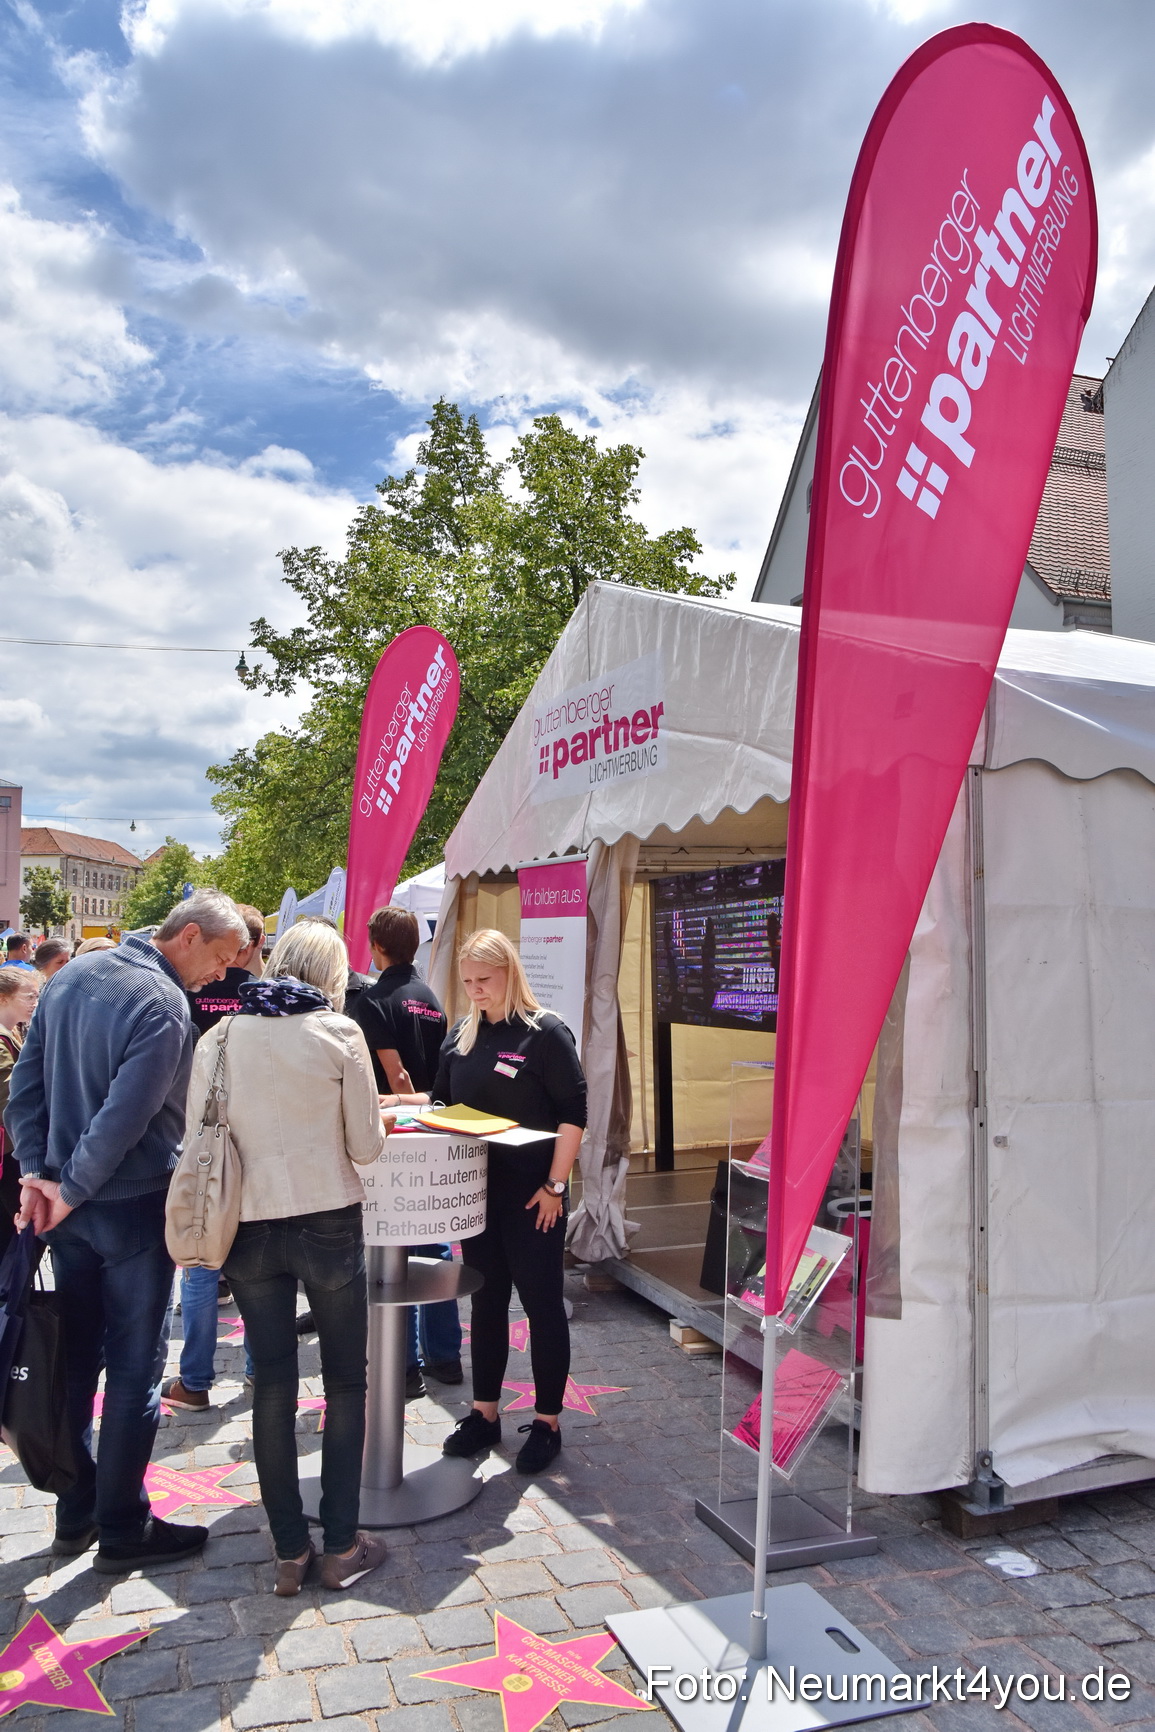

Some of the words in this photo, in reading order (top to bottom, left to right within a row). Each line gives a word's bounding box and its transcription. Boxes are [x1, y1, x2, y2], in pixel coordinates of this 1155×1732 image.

[920, 95, 1062, 468] partner
[1003, 165, 1080, 365] LICHTWERBUNG
[839, 168, 981, 519] guttenberger
[385, 644, 447, 795] partner
[414, 667, 453, 752] LICHTWERBUNG
[533, 684, 615, 747] guttenberger
[359, 681, 413, 818] guttenberger
[552, 701, 664, 780] partner
[589, 744, 658, 784] LICHTWERBUNG
[534, 887, 561, 906] bilden
[561, 888, 583, 904] aus.
[209, 1003, 243, 1013] part
[390, 1172, 404, 1188] K
[409, 1171, 424, 1188] in
[429, 1168, 478, 1187] Lautern
[376, 1220, 446, 1237] Rathaus
[450, 1210, 484, 1232] Galerie
[28, 1641, 73, 1691] LACKIERER
[505, 1652, 572, 1697] KANTPRESSE
[520, 1635, 605, 1689] CNC-MASCHINEN-
[524, 1651, 577, 1685] BEDIENER
